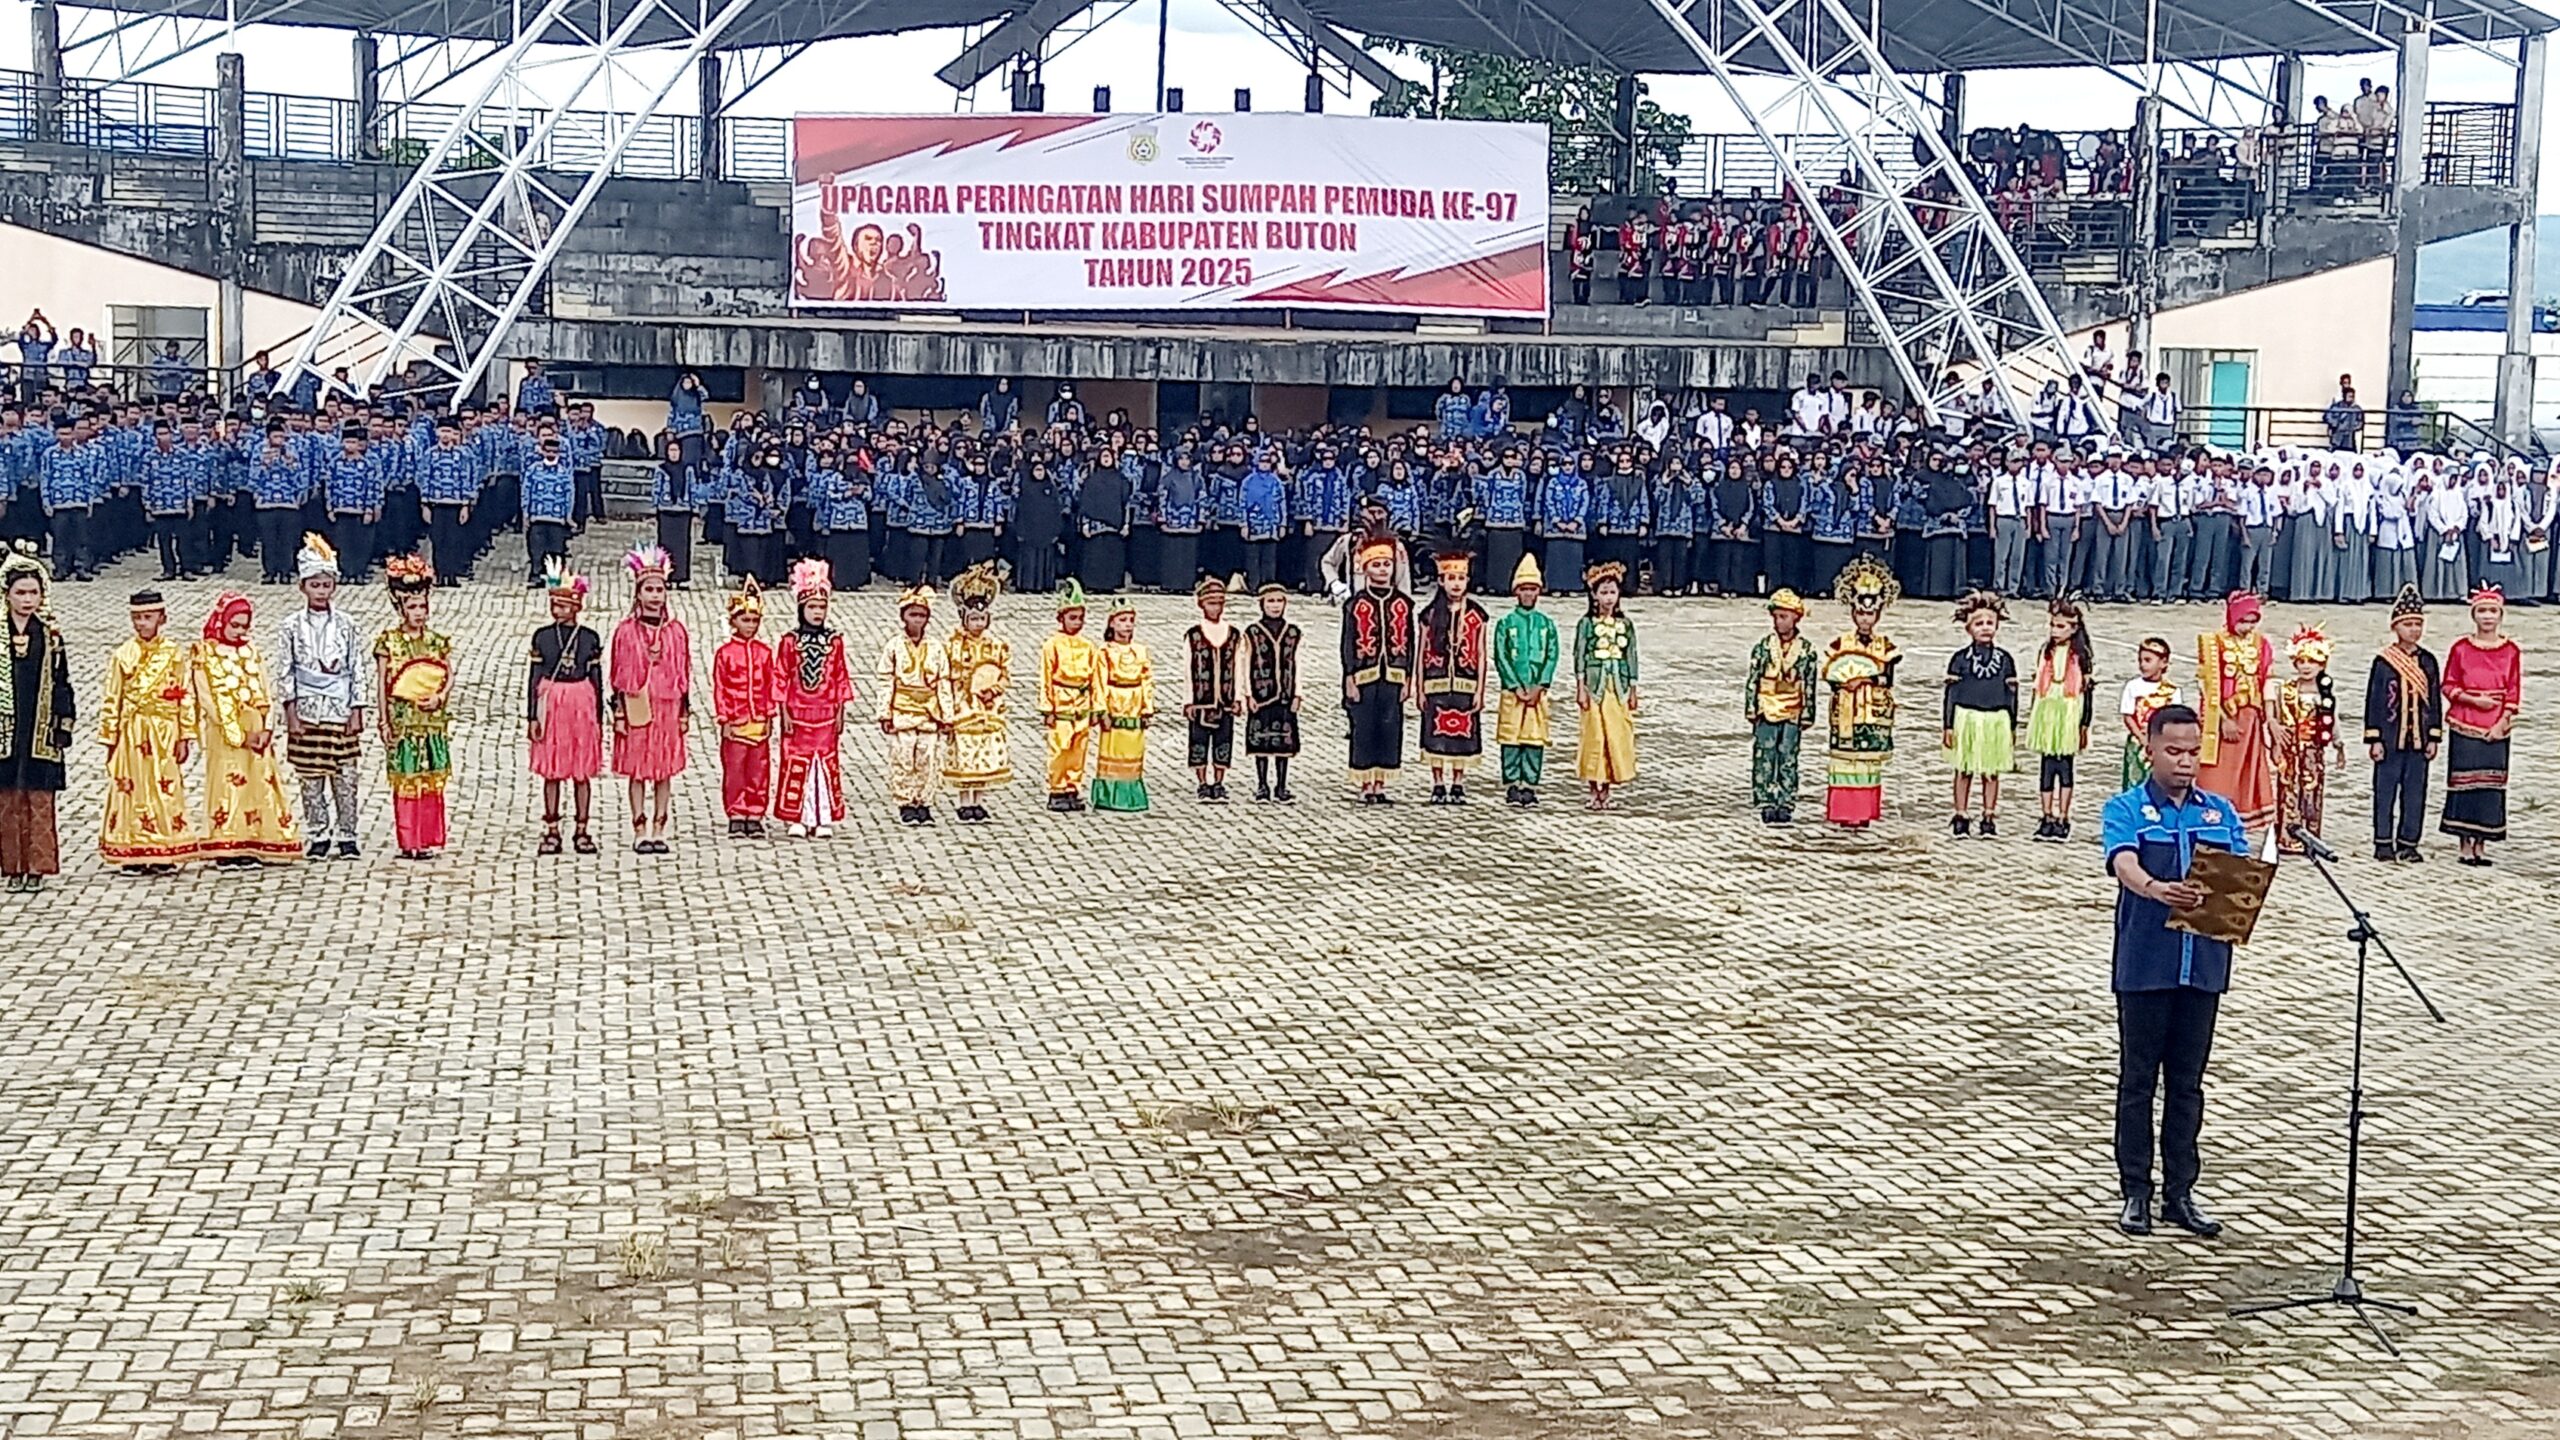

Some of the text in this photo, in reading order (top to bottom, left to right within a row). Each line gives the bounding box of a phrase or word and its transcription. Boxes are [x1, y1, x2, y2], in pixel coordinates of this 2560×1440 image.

[821, 184, 1517, 222] UPACARA PERINGATAN HARI SUMPAH PEMUDA KE-97
[980, 221, 1357, 251] TINGKAT KABUPATEN BUTON
[1085, 257, 1252, 287] TAHUN 2025
